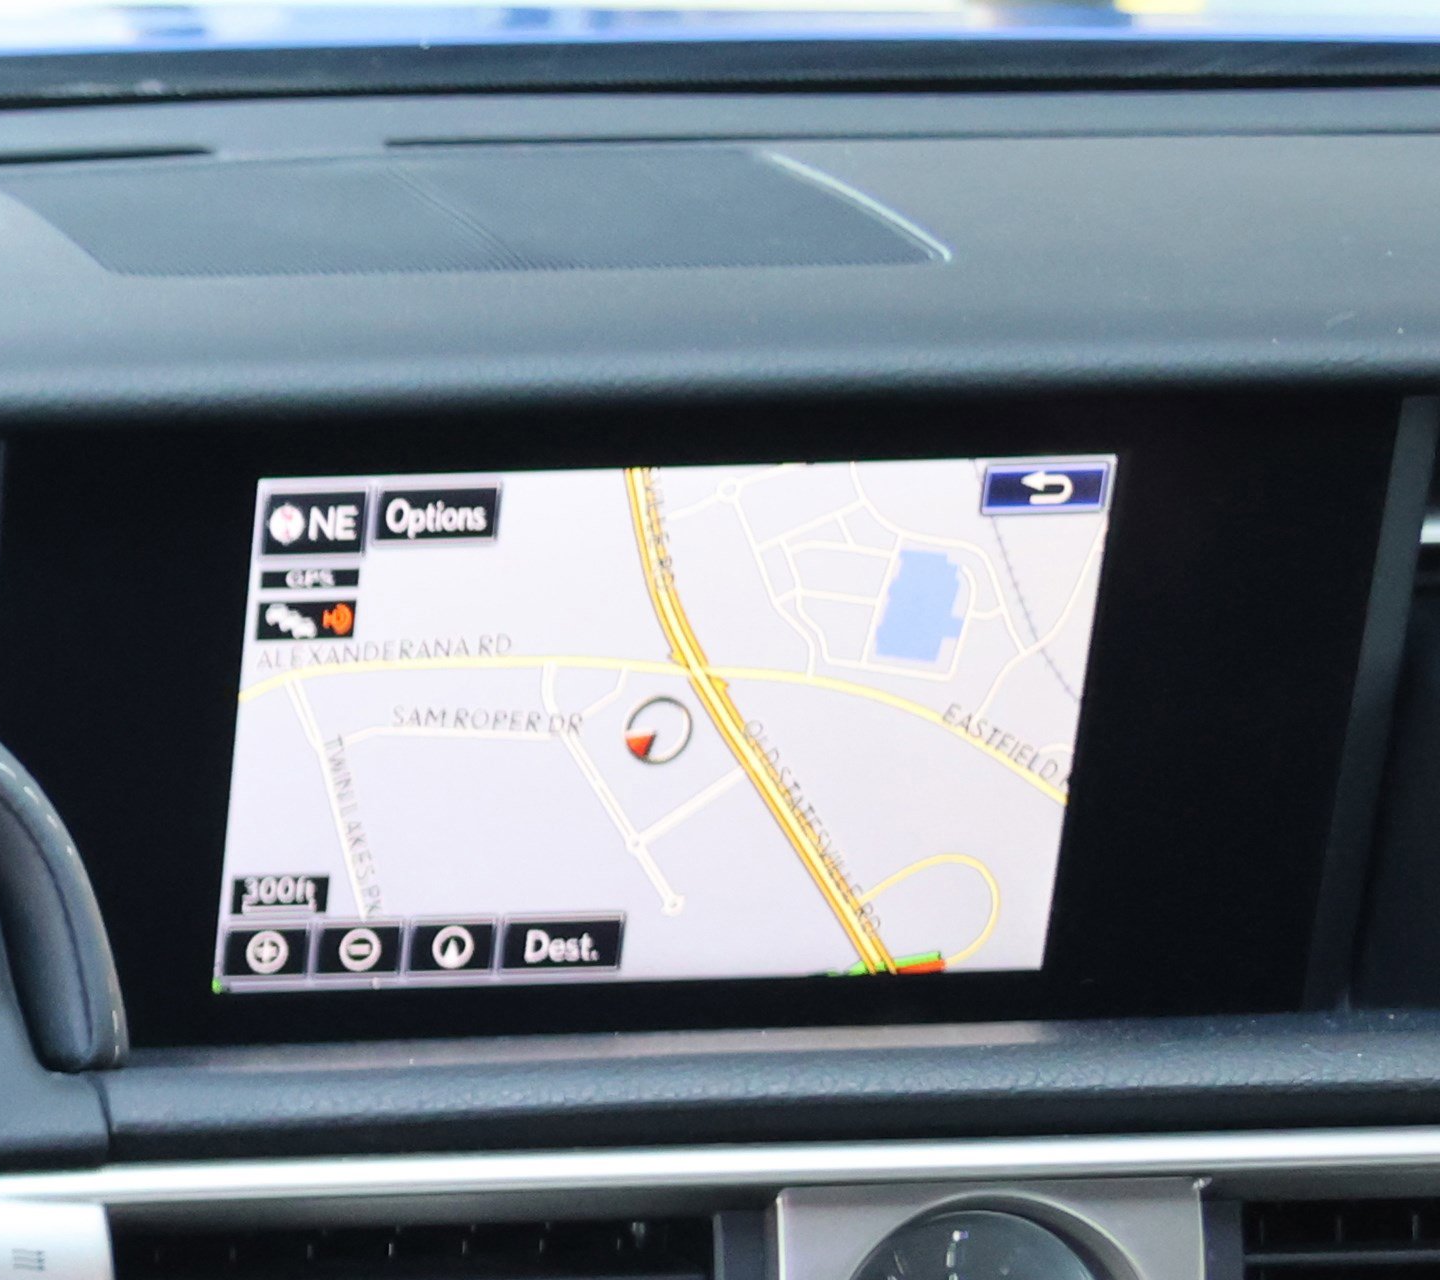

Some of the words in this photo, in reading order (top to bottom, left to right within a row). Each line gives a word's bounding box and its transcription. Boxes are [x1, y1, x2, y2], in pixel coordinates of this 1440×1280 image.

[309, 505, 359, 541] NE
[385, 498, 488, 539] Options
[479, 634, 512, 656] RD
[392, 705, 447, 729] SAM
[453, 708, 542, 733] ROPER
[549, 713, 584, 735] DR
[942, 703, 1058, 780] EASTFIELD
[524, 929, 599, 964] Dest.
